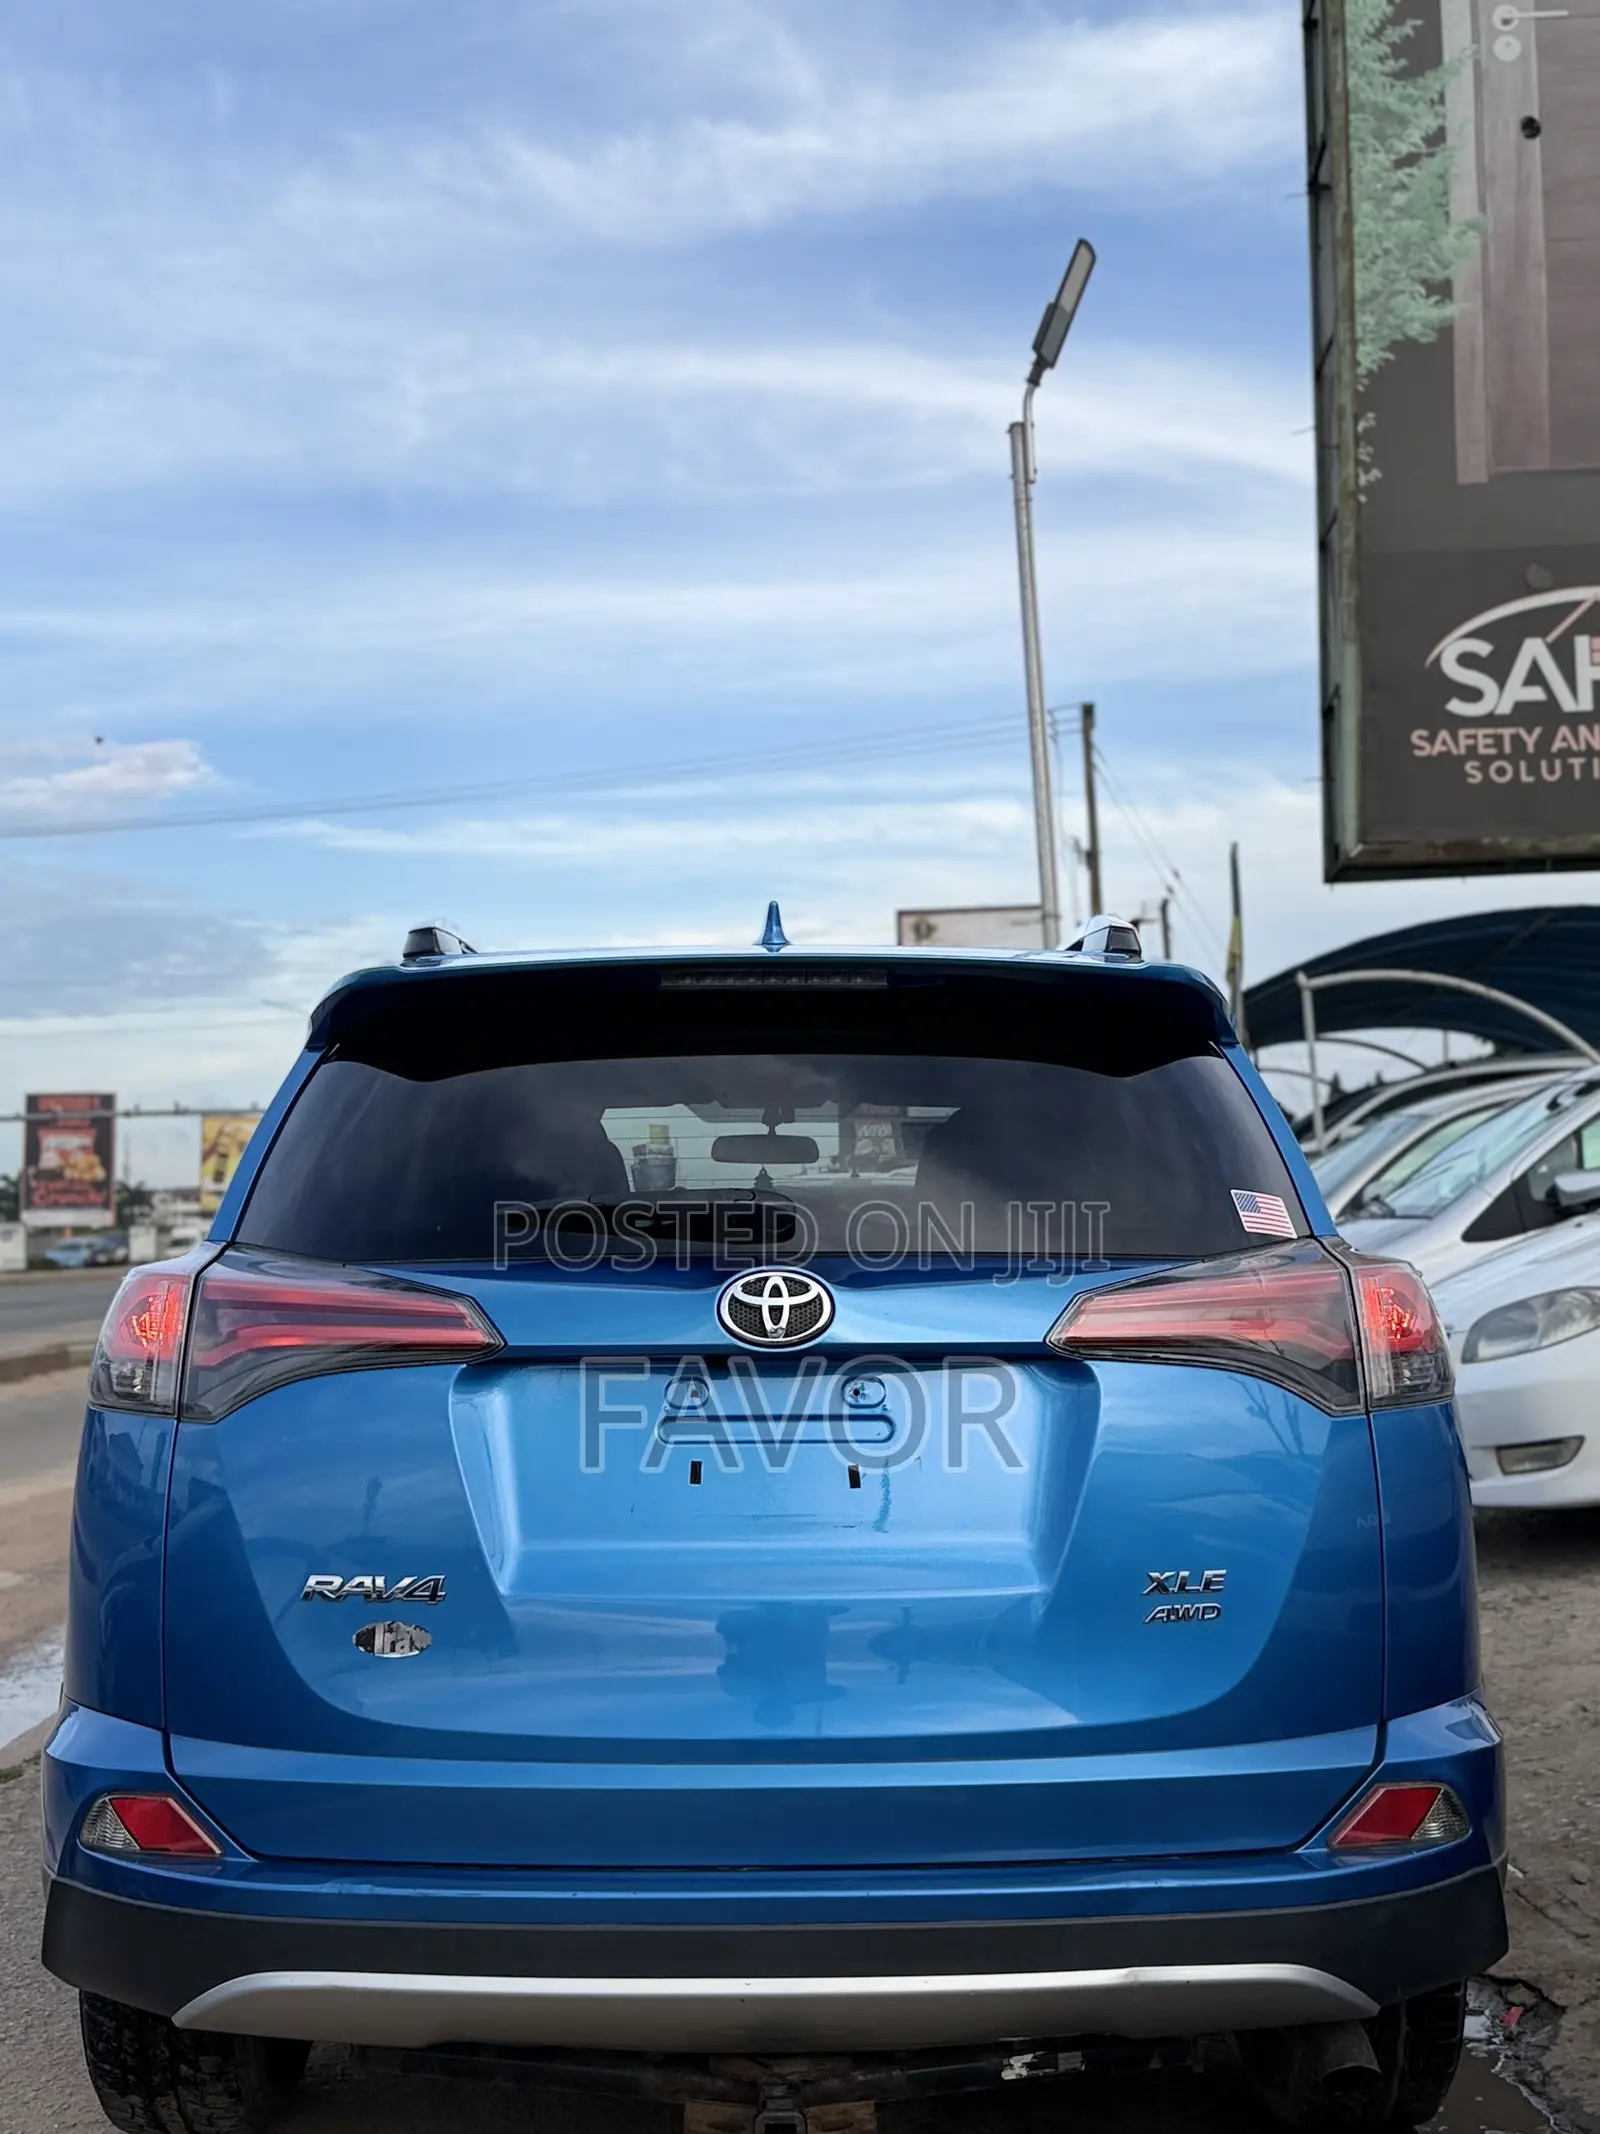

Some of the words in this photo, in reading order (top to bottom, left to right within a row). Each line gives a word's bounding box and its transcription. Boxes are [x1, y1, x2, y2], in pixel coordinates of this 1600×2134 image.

[1411, 727, 1543, 756] SAFETY
[1464, 758, 1600, 784] SOLUTI
[301, 1574, 446, 1604] RAV4
[1141, 1569, 1227, 1595] XLE
[1144, 1602, 1222, 1624] AWD
